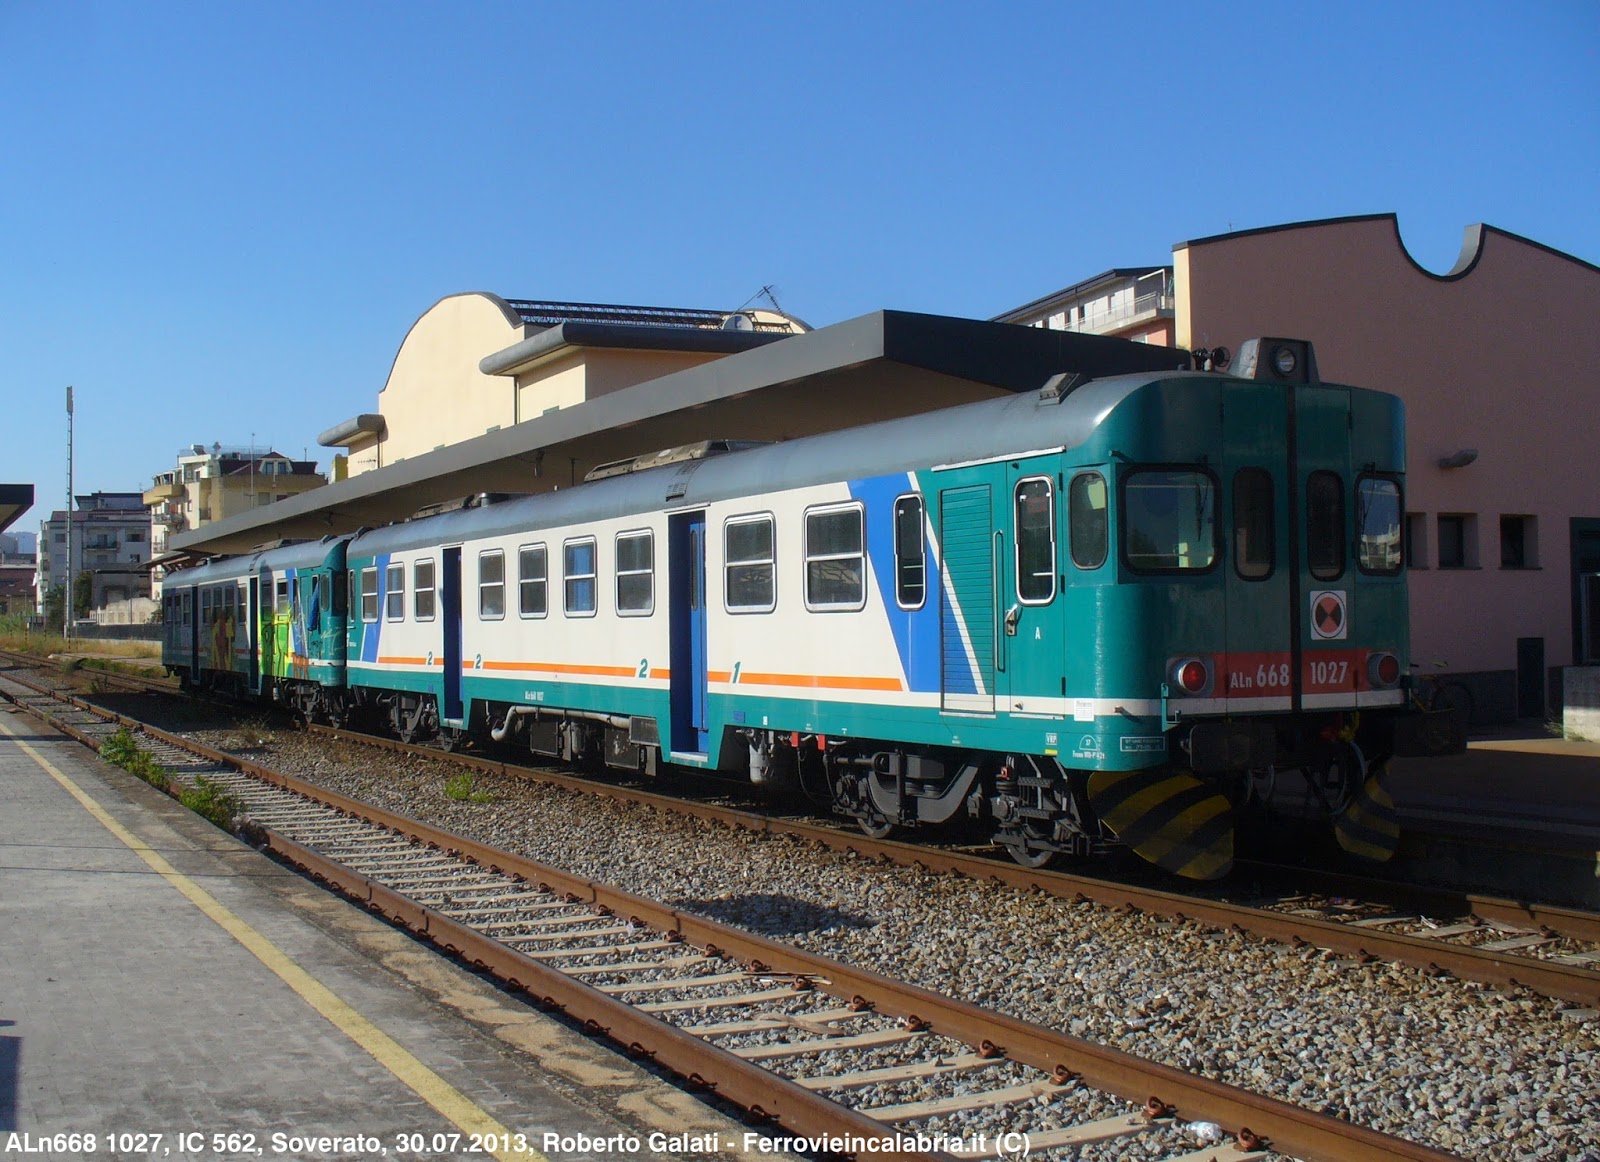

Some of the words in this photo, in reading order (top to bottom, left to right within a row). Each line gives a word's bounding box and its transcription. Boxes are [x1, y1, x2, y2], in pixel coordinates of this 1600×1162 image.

[1034, 626, 1041, 640] A
[427, 650, 433, 666] 2
[475, 653, 482, 669] 2
[638, 658, 649, 679] 2
[732, 661, 741, 684] 1
[1230, 672, 1252, 688] ALn
[1256, 663, 1290, 688] 668
[1310, 661, 1348, 685] 1027
